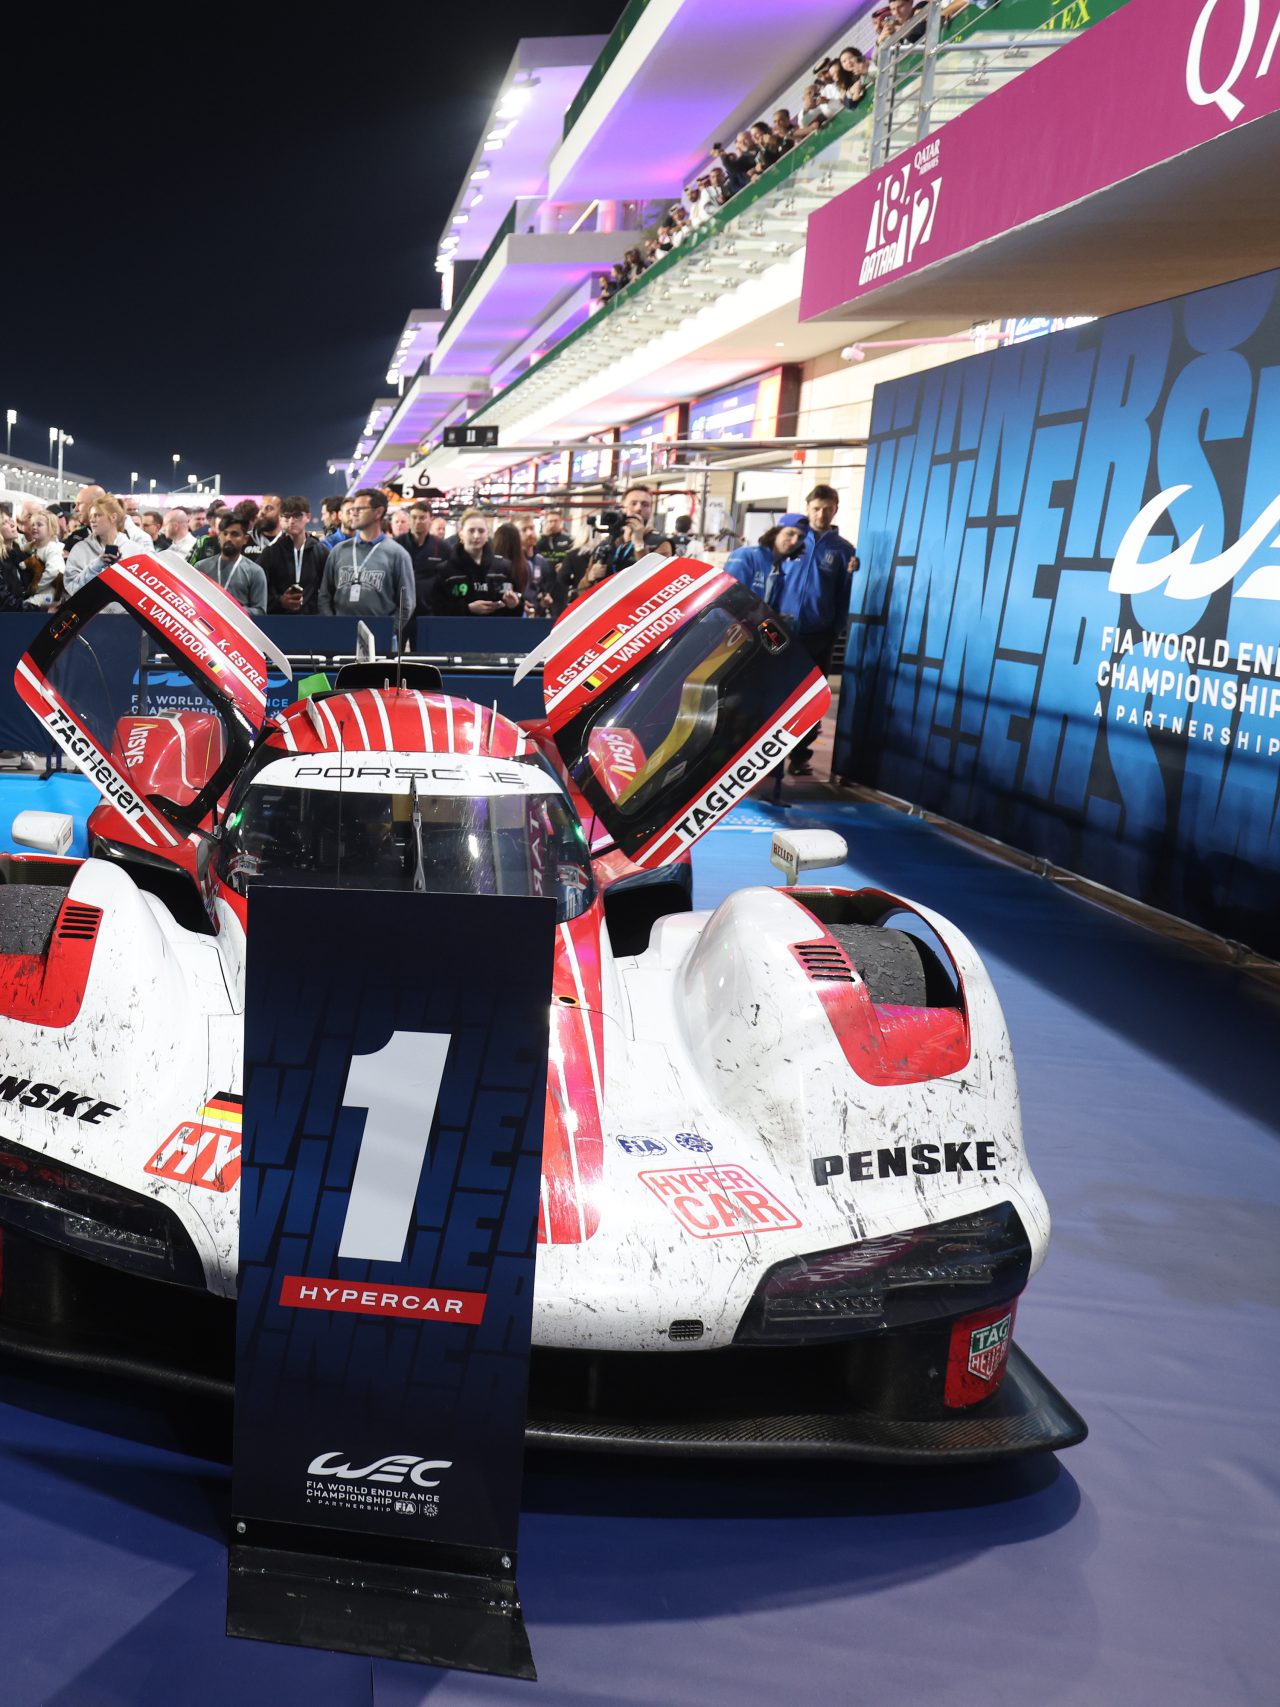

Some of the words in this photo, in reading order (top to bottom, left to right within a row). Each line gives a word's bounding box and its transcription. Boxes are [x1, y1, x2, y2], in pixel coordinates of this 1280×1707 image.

[914, 138, 941, 169] QATAR
[402, 483, 415, 499] 5
[418, 468, 430, 487] 6
[127, 562, 139, 578] A.
[138, 570, 196, 620] LOTTERER
[215, 637, 229, 656] K.
[227, 649, 266, 688] ESTRE
[136, 597, 149, 612] L.
[148, 607, 210, 661] VANTHOOR
[544, 685, 560, 699] K.
[556, 648, 600, 688] ESTRE
[616, 620, 634, 635] A.
[630, 572, 696, 628] LOTTERER
[602, 661, 621, 675] L.
[616, 606, 686, 664] VANTHOOR
[1101, 626, 1134, 656] FIA
[1142, 630, 1230, 668] WORLD
[132, 694, 152, 704] FA
[156, 695, 204, 706] WORLD
[1093, 700, 1103, 718] A
[1115, 704, 1280, 757] PARTNERSHIP
[126, 721, 159, 769] Ansys
[295, 766, 524, 785] PORSCHE
[337, 1030, 453, 1263] 1
[617, 1139, 665, 1153] FIA
[812, 1140, 997, 1187] PENSKE
[648, 1169, 754, 1196] HYPER
[673, 1190, 788, 1230] CAR
[299, 1285, 464, 1315] HYPERCAR
[976, 1321, 1009, 1349] TAG
[307, 1451, 453, 1488] WEC
[306, 1481, 324, 1489] FIA
[327, 1483, 368, 1494] WORLD
[371, 1488, 440, 1503] ENDURANCE
[306, 1489, 392, 1505] CHAMPIONSHIP
[395, 1501, 416, 1513] FIA
[318, 1500, 391, 1513] PARTNERSHIP
